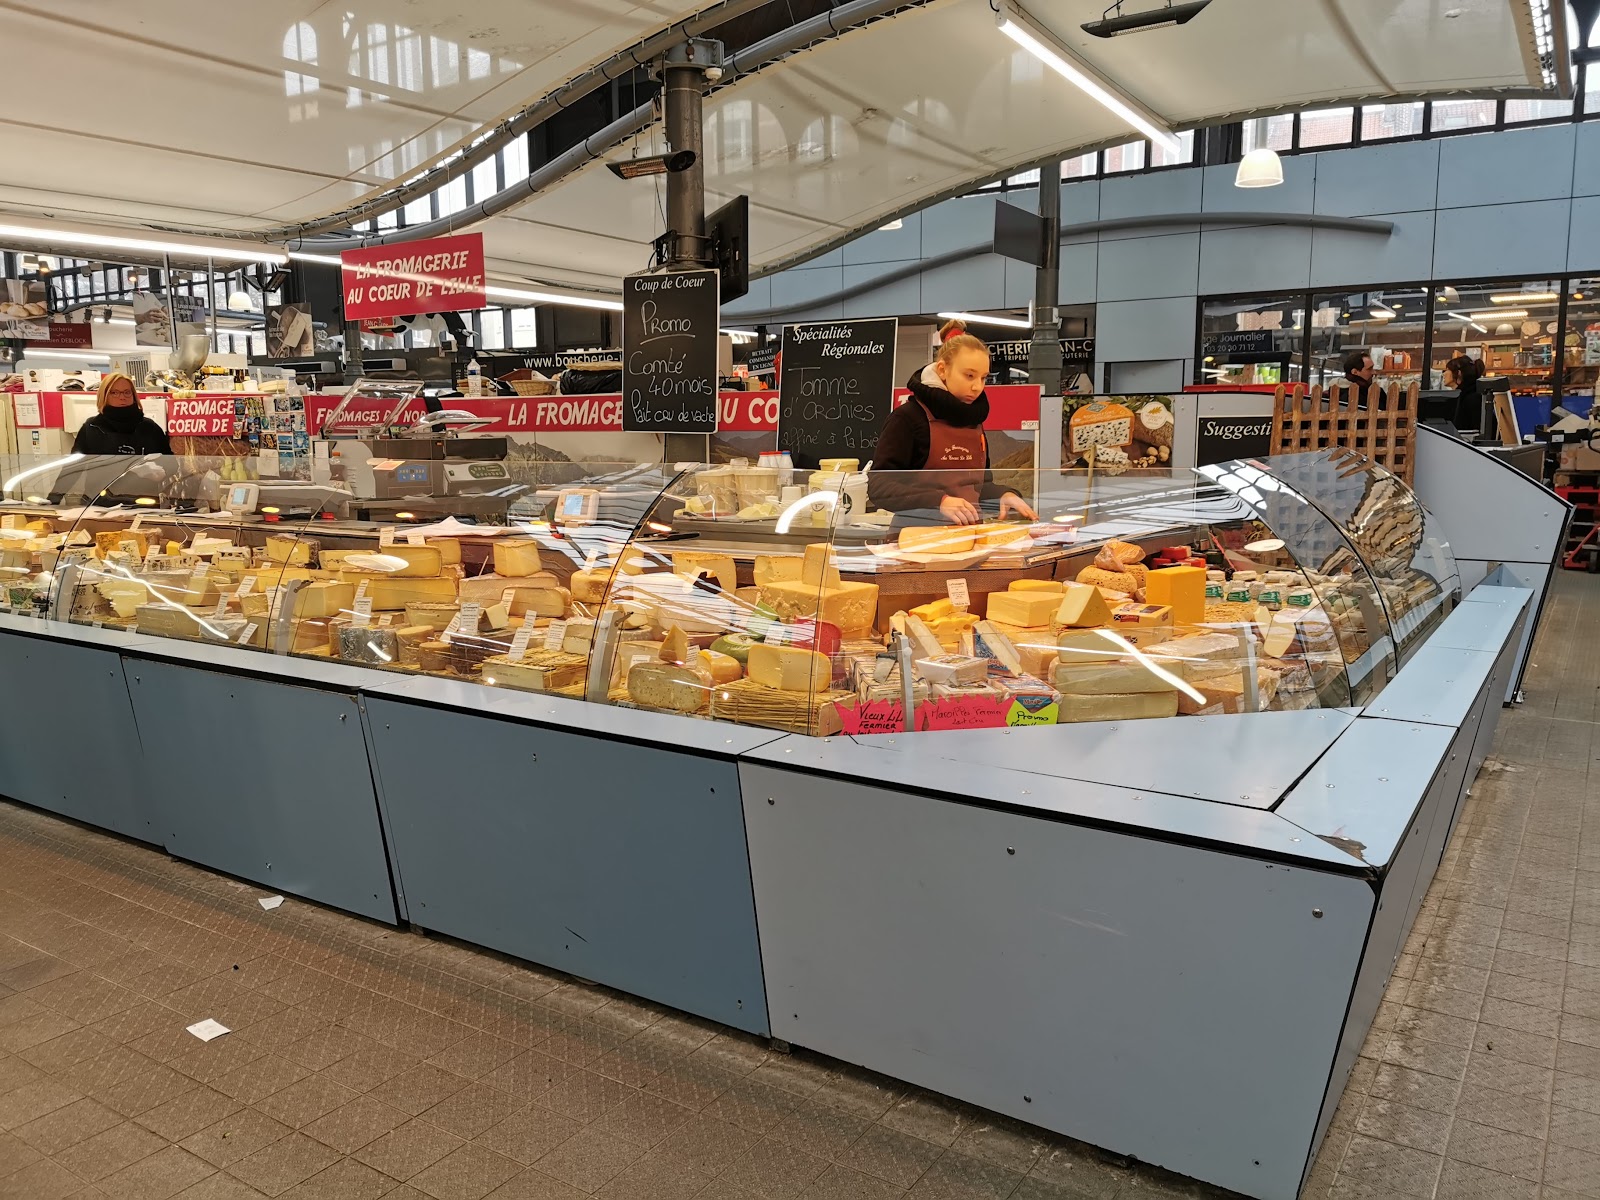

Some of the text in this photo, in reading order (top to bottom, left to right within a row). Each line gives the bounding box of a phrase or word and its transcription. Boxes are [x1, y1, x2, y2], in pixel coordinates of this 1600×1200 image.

[356, 250, 470, 280] LA FROMAGERIE
[347, 274, 482, 305] AU COEUR DE LILLE
[634, 275, 705, 293] Coup de Coeur
[793, 325, 853, 344] Spécialités
[1220, 332, 1266, 342] Journalier
[821, 341, 884, 359] Régionales
[628, 348, 687, 375] Comté
[788, 366, 860, 397] Tomme
[508, 402, 527, 426] LA
[536, 400, 622, 426] FROMAGE
[748, 397, 779, 424] CO
[678, 403, 690, 422] de
[691, 406, 715, 423] vache
[168, 419, 207, 433] COEUR
[212, 419, 229, 432] DE
[1204, 421, 1271, 440] Suggesti
[826, 432, 837, 445] à
[860, 703, 885, 720] Vieux
[1017, 711, 1049, 721] Promo
[859, 721, 896, 729] Fermier
